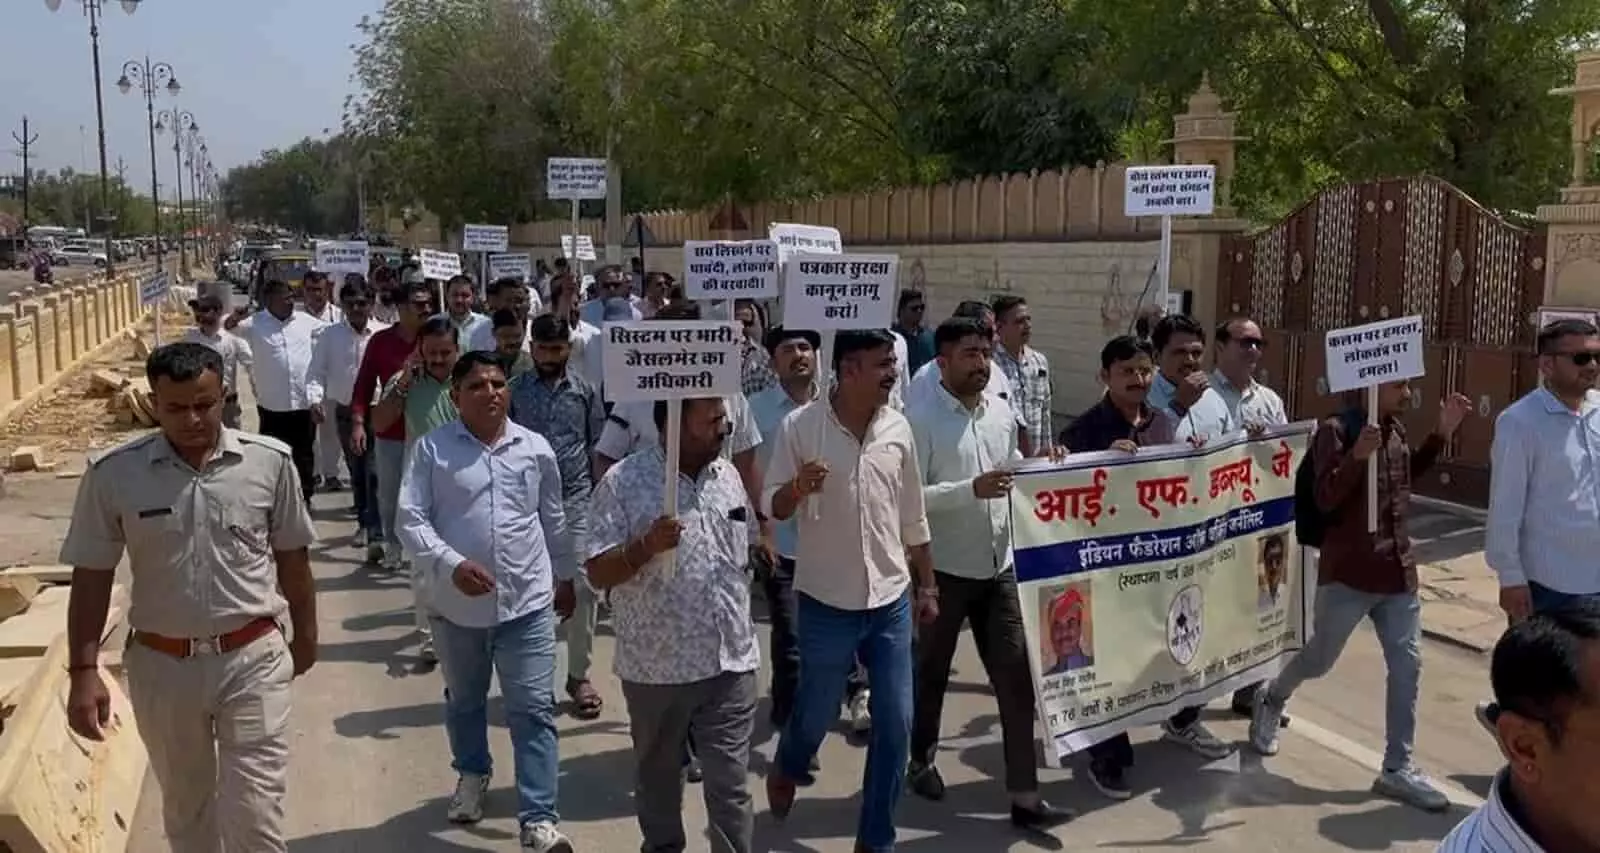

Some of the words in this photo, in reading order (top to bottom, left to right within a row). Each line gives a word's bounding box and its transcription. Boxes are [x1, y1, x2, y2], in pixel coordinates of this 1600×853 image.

[1170, 170, 1182, 180] पर
[756, 244, 772, 256] पर
[799, 261, 847, 276] पत्रकार
[849, 261, 889, 281] सुरक्षा
[702, 278, 718, 290] की
[805, 284, 848, 302] कानून
[850, 284, 881, 302] लागू
[610, 325, 668, 345] सिस्टम
[670, 329, 693, 344] पर
[695, 326, 739, 345] भारी,
[1328, 333, 1363, 348] कलम
[1364, 329, 1380, 341] पर
[625, 349, 697, 368] जैसलमेर
[701, 351, 725, 367] का
[1343, 343, 1391, 363] लोकतंत्र
[1392, 342, 1409, 354] पर
[637, 372, 713, 391] अधिकारी
[1271, 440, 1293, 479] जे
[1077, 538, 1123, 568] इंडियन
